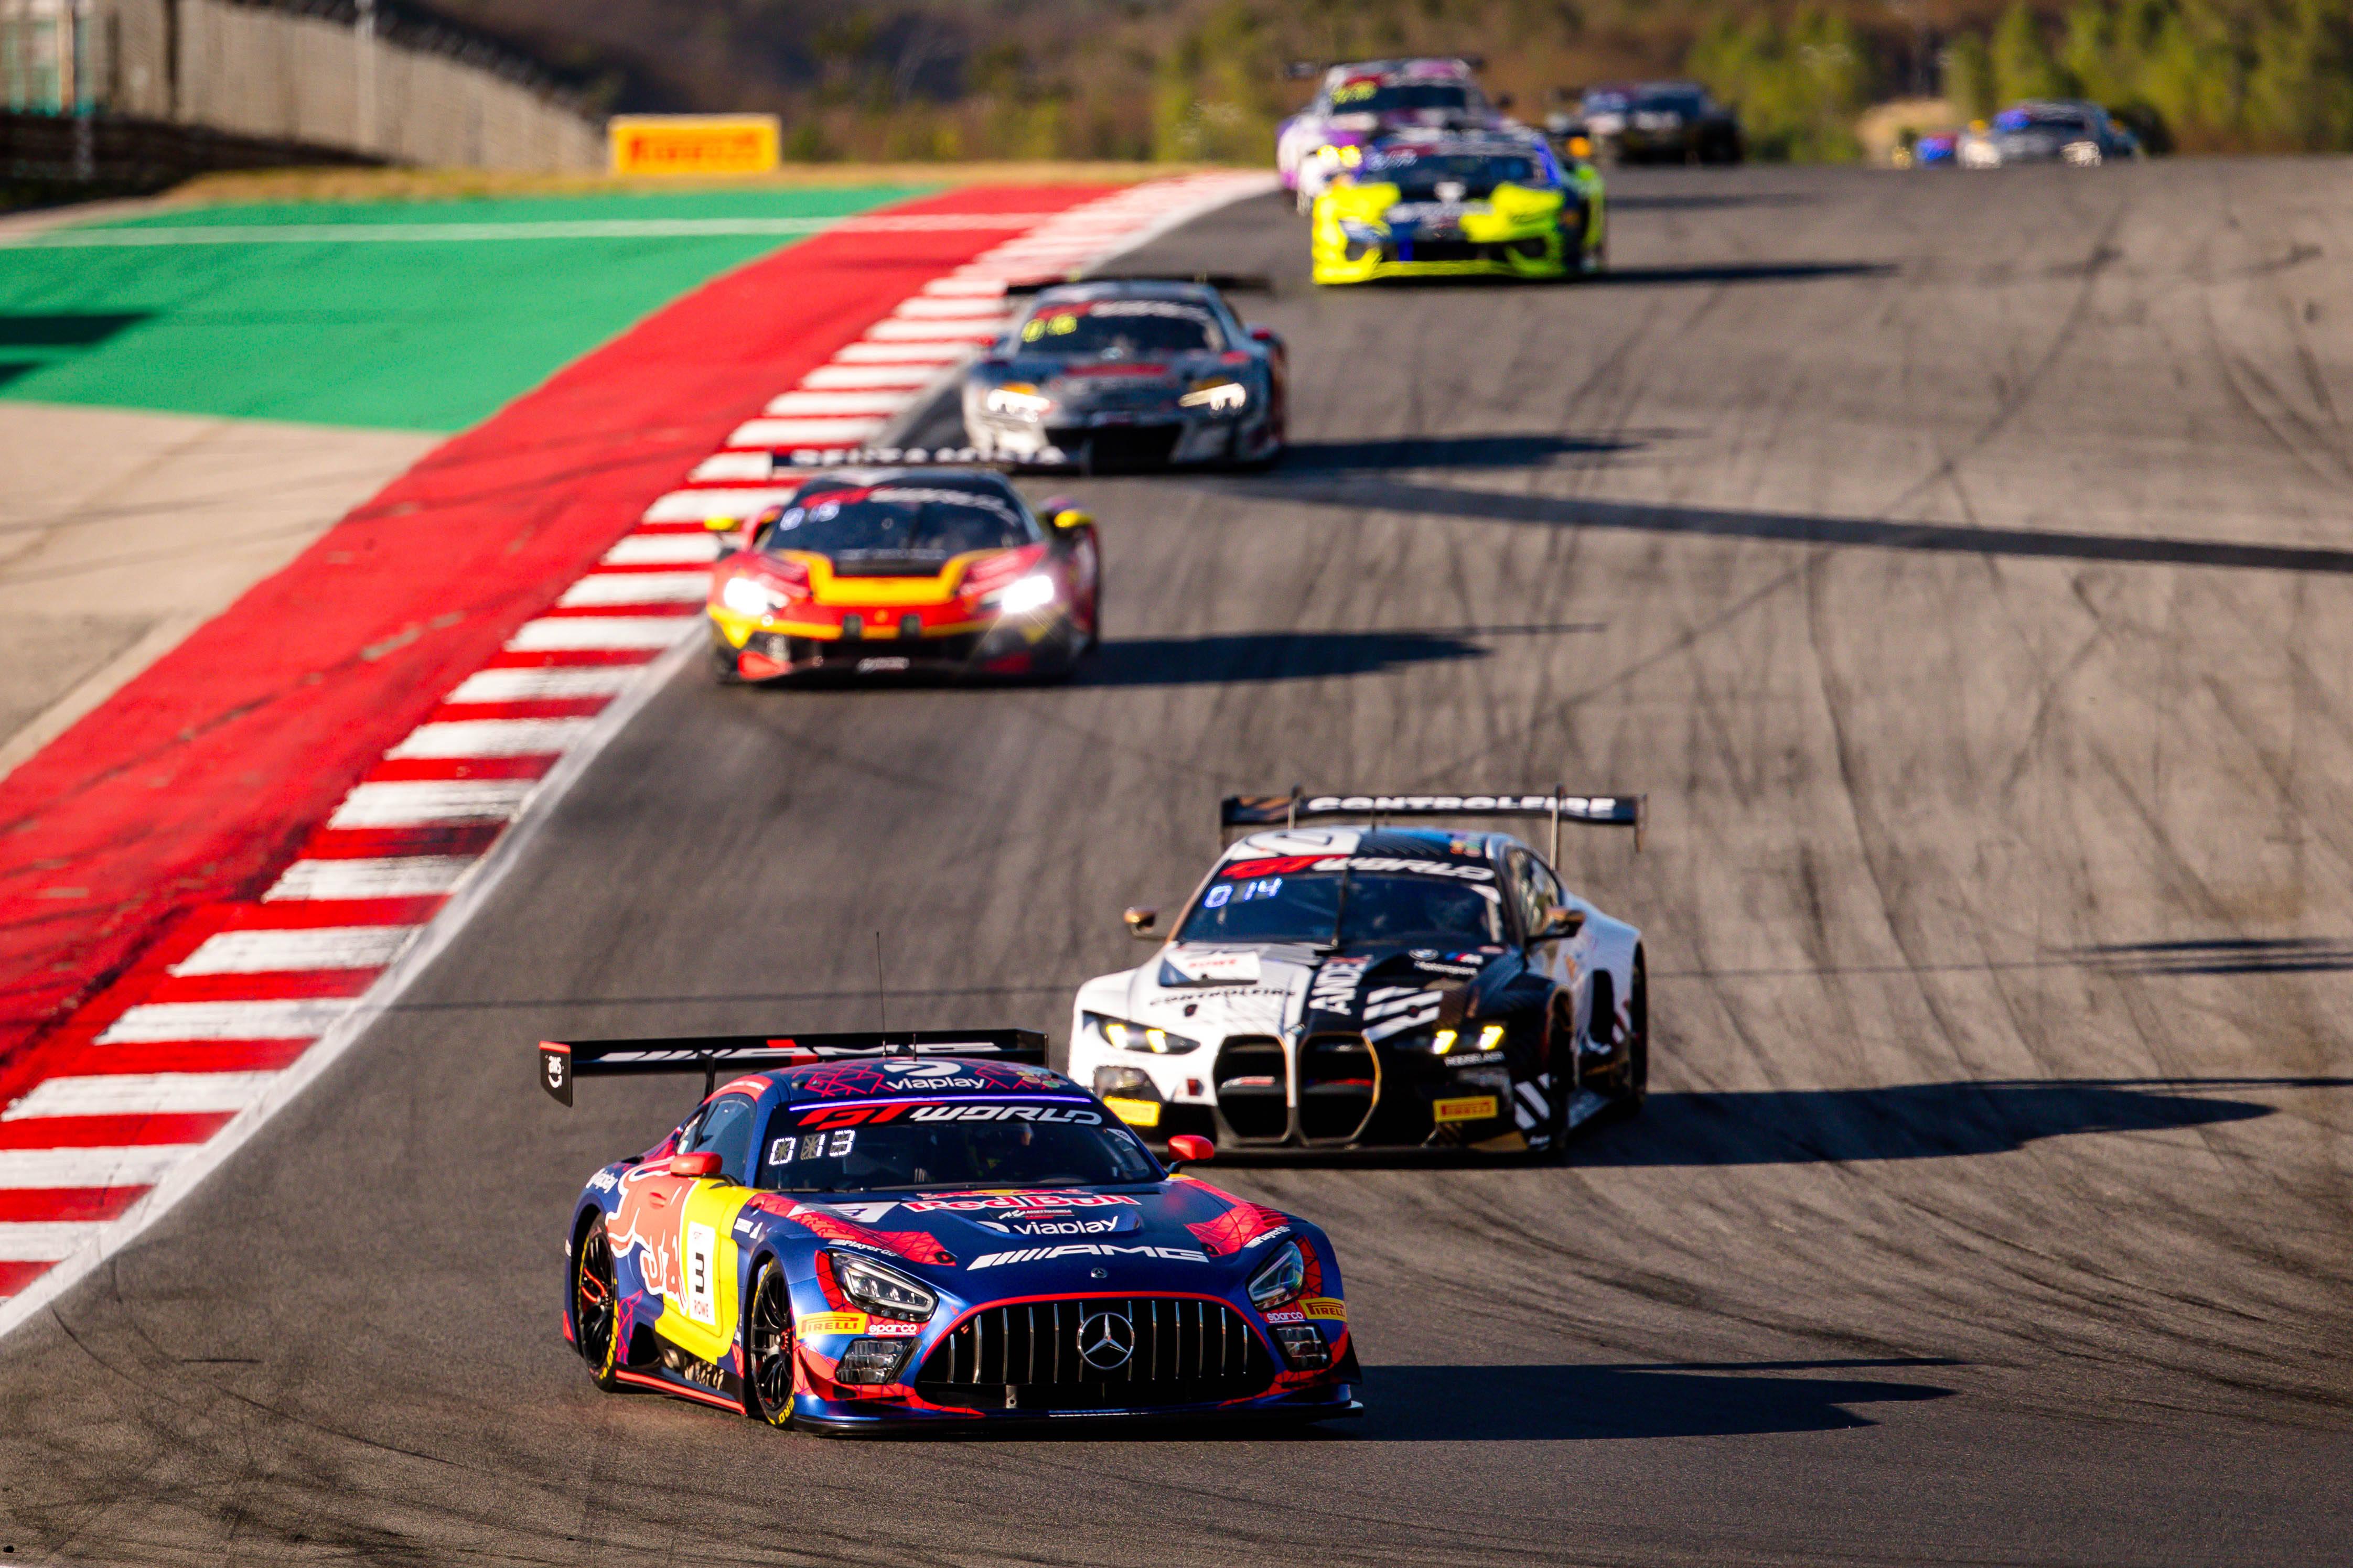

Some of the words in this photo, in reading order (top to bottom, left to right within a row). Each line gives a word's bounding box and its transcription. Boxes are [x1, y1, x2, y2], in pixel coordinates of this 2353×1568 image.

[1311, 858, 1496, 881] WORLD
[549, 1055, 562, 1075] aws
[886, 1075, 985, 1090] viaplay
[798, 1101, 948, 1131] GT
[909, 1106, 1102, 1125] WORLD
[901, 1196, 1026, 1213] Red
[1019, 1194, 1142, 1206] Bull
[1013, 1216, 1118, 1235] viaplay
[695, 1251, 704, 1294] 3
[1267, 1312, 1305, 1323] sparco
[1306, 1301, 1346, 1317] PIRELL
[801, 1316, 859, 1333] PIRELLI
[868, 1324, 917, 1335] sparco
